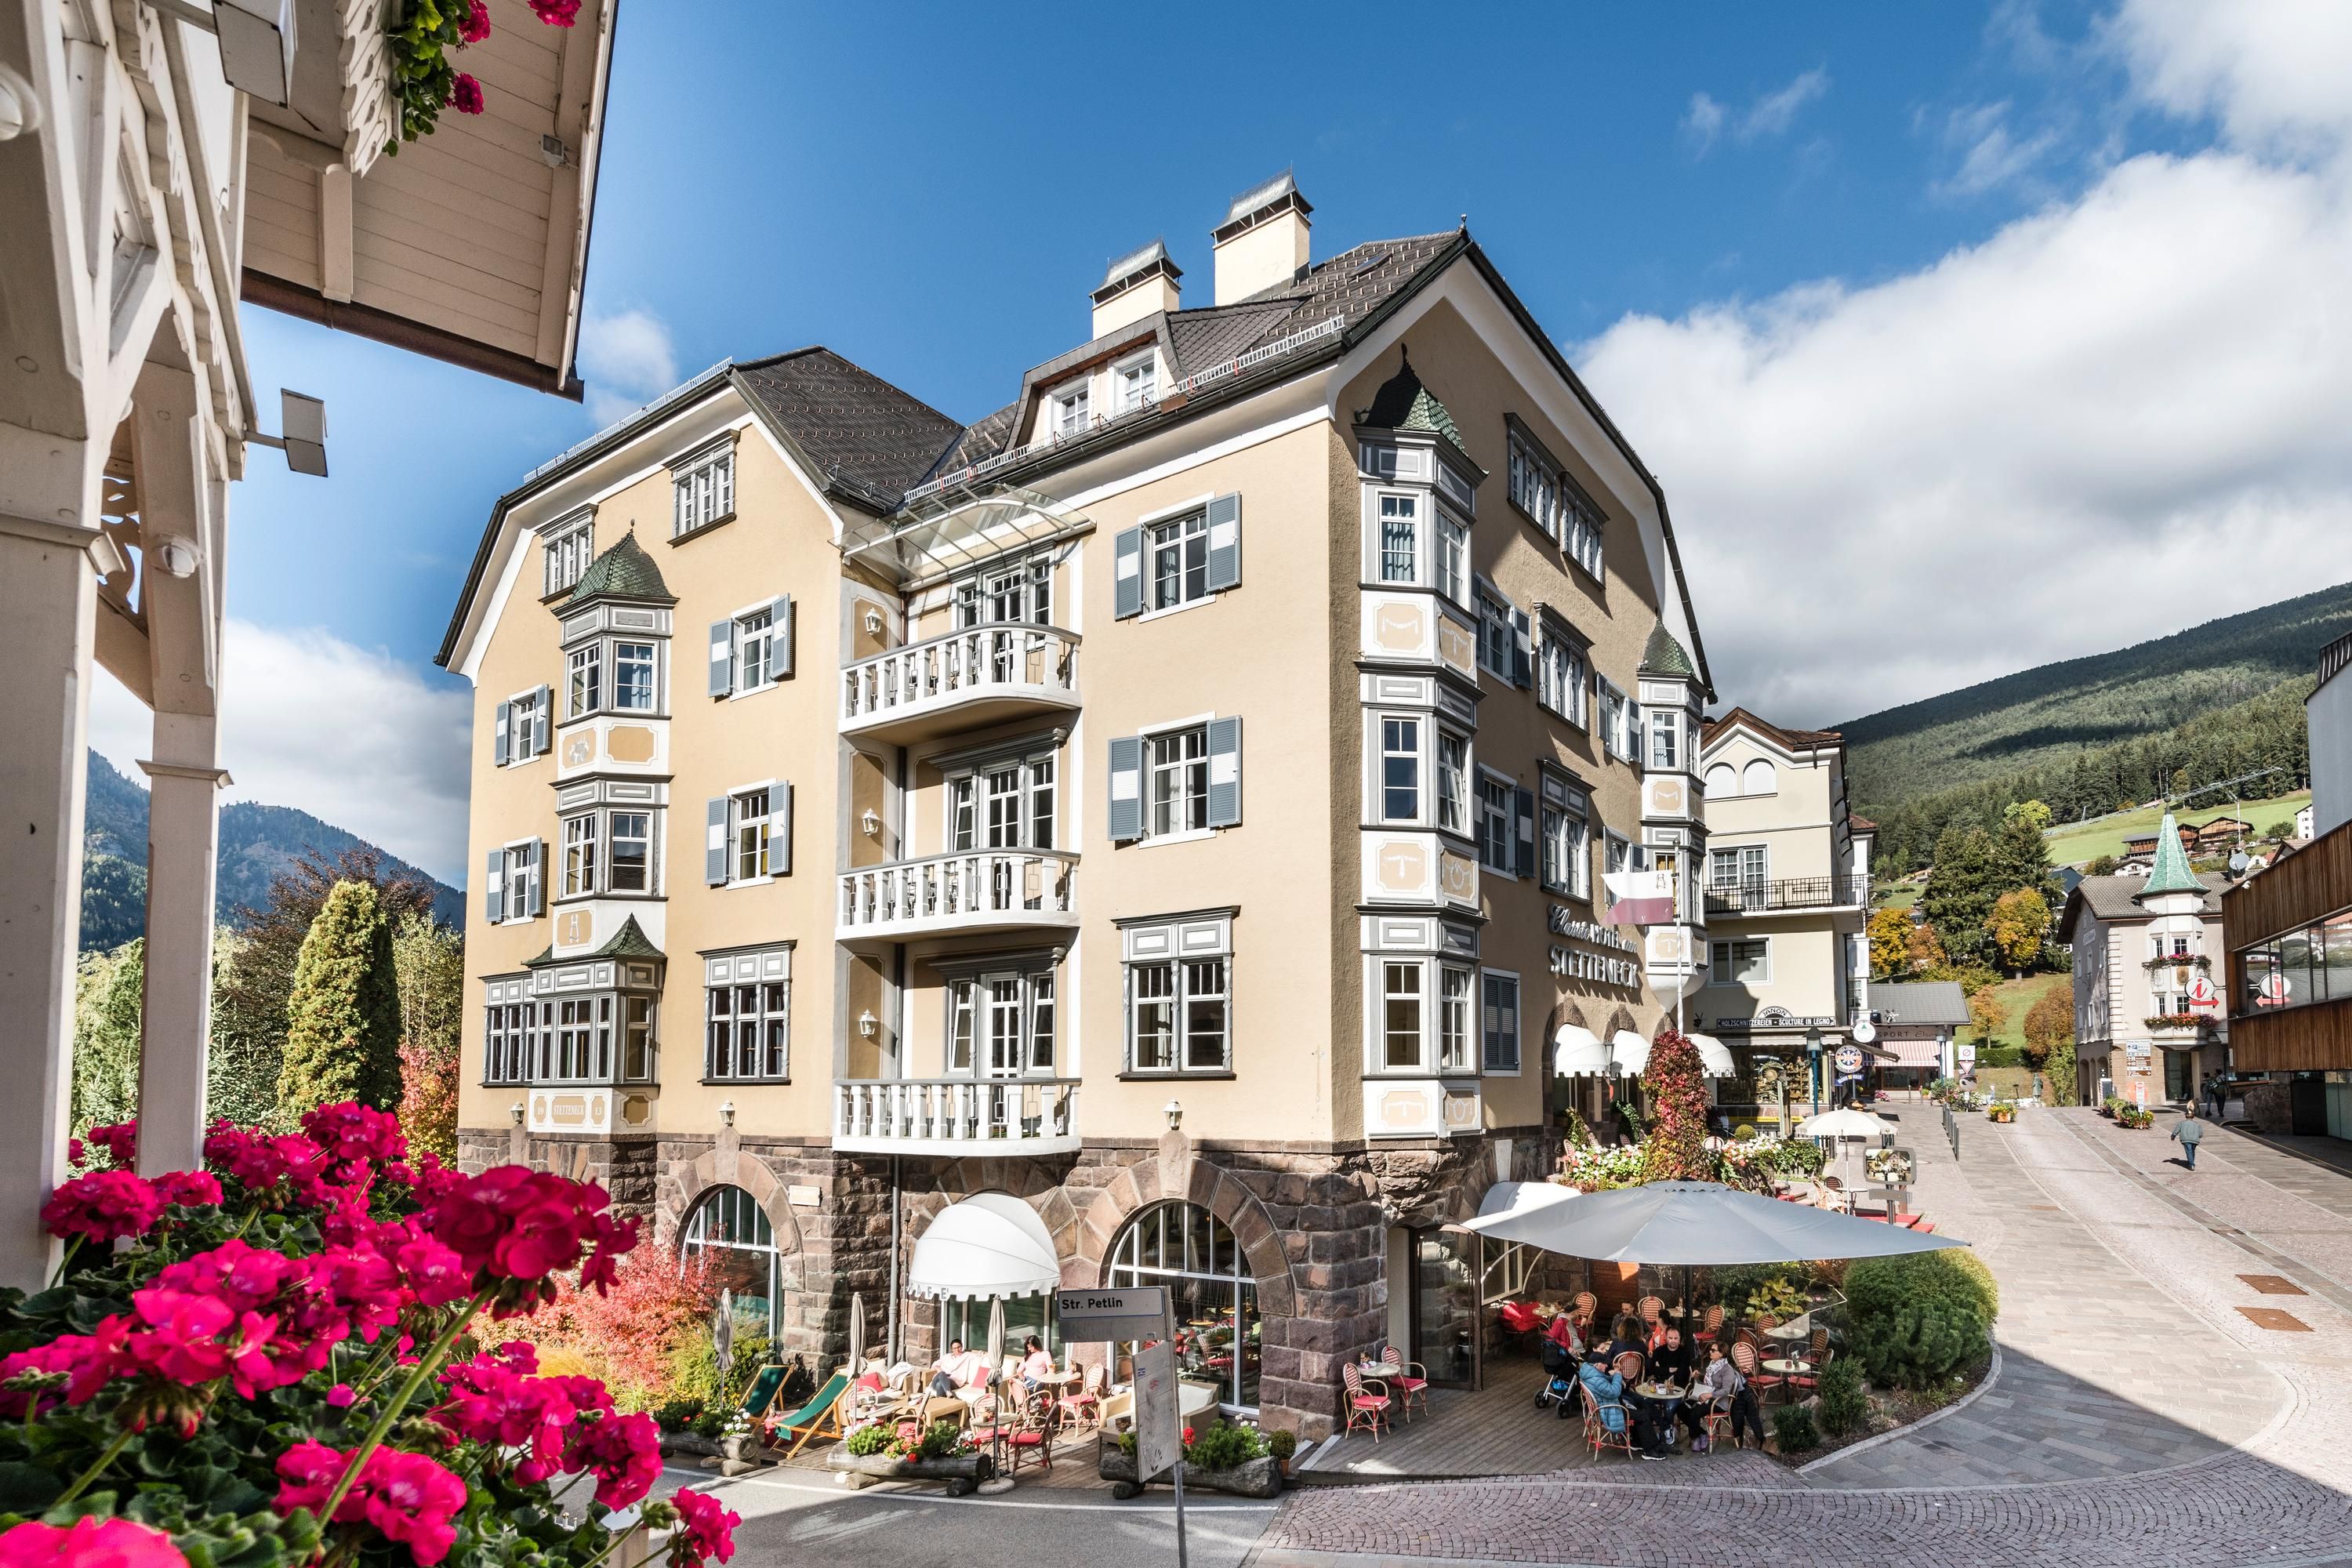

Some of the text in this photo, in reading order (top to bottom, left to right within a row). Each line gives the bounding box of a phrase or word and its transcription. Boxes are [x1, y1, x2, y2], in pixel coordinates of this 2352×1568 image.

[1590, 924, 1621, 949] HOTEL
[1549, 945, 1639, 989] STETTENECK
[1762, 1007, 1788, 1017] JANON
[1721, 1018, 1773, 1027] HOLZSCHNITZEREIEN
[538, 1106, 544, 1116] 19
[1062, 1298, 1123, 1310] Str. Petlin
